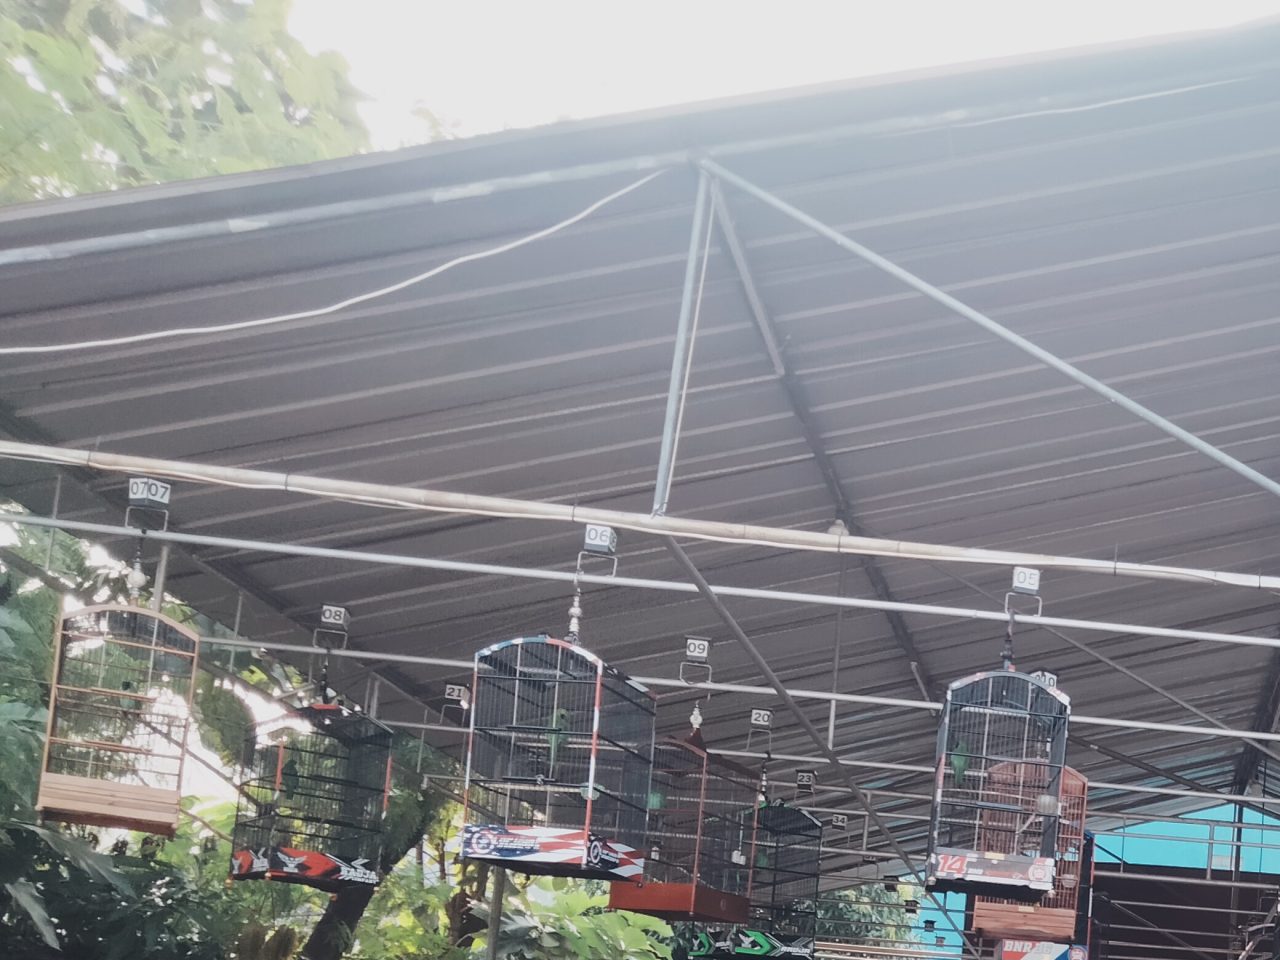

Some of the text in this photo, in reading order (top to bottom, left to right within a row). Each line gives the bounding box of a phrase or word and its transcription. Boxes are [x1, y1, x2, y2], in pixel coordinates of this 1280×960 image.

[130, 481, 147, 496] 07
[148, 483, 169, 499] 07
[587, 527, 608, 541] 06
[1017, 571, 1038, 586] 05
[322, 608, 342, 622] 08
[687, 642, 706, 654] 09
[447, 687, 463, 698] 21
[754, 712, 770, 722] 20
[798, 774, 812, 783] 23
[832, 815, 846, 824] 34
[937, 855, 968, 874] 14
[1003, 940, 1033, 953] BNR
